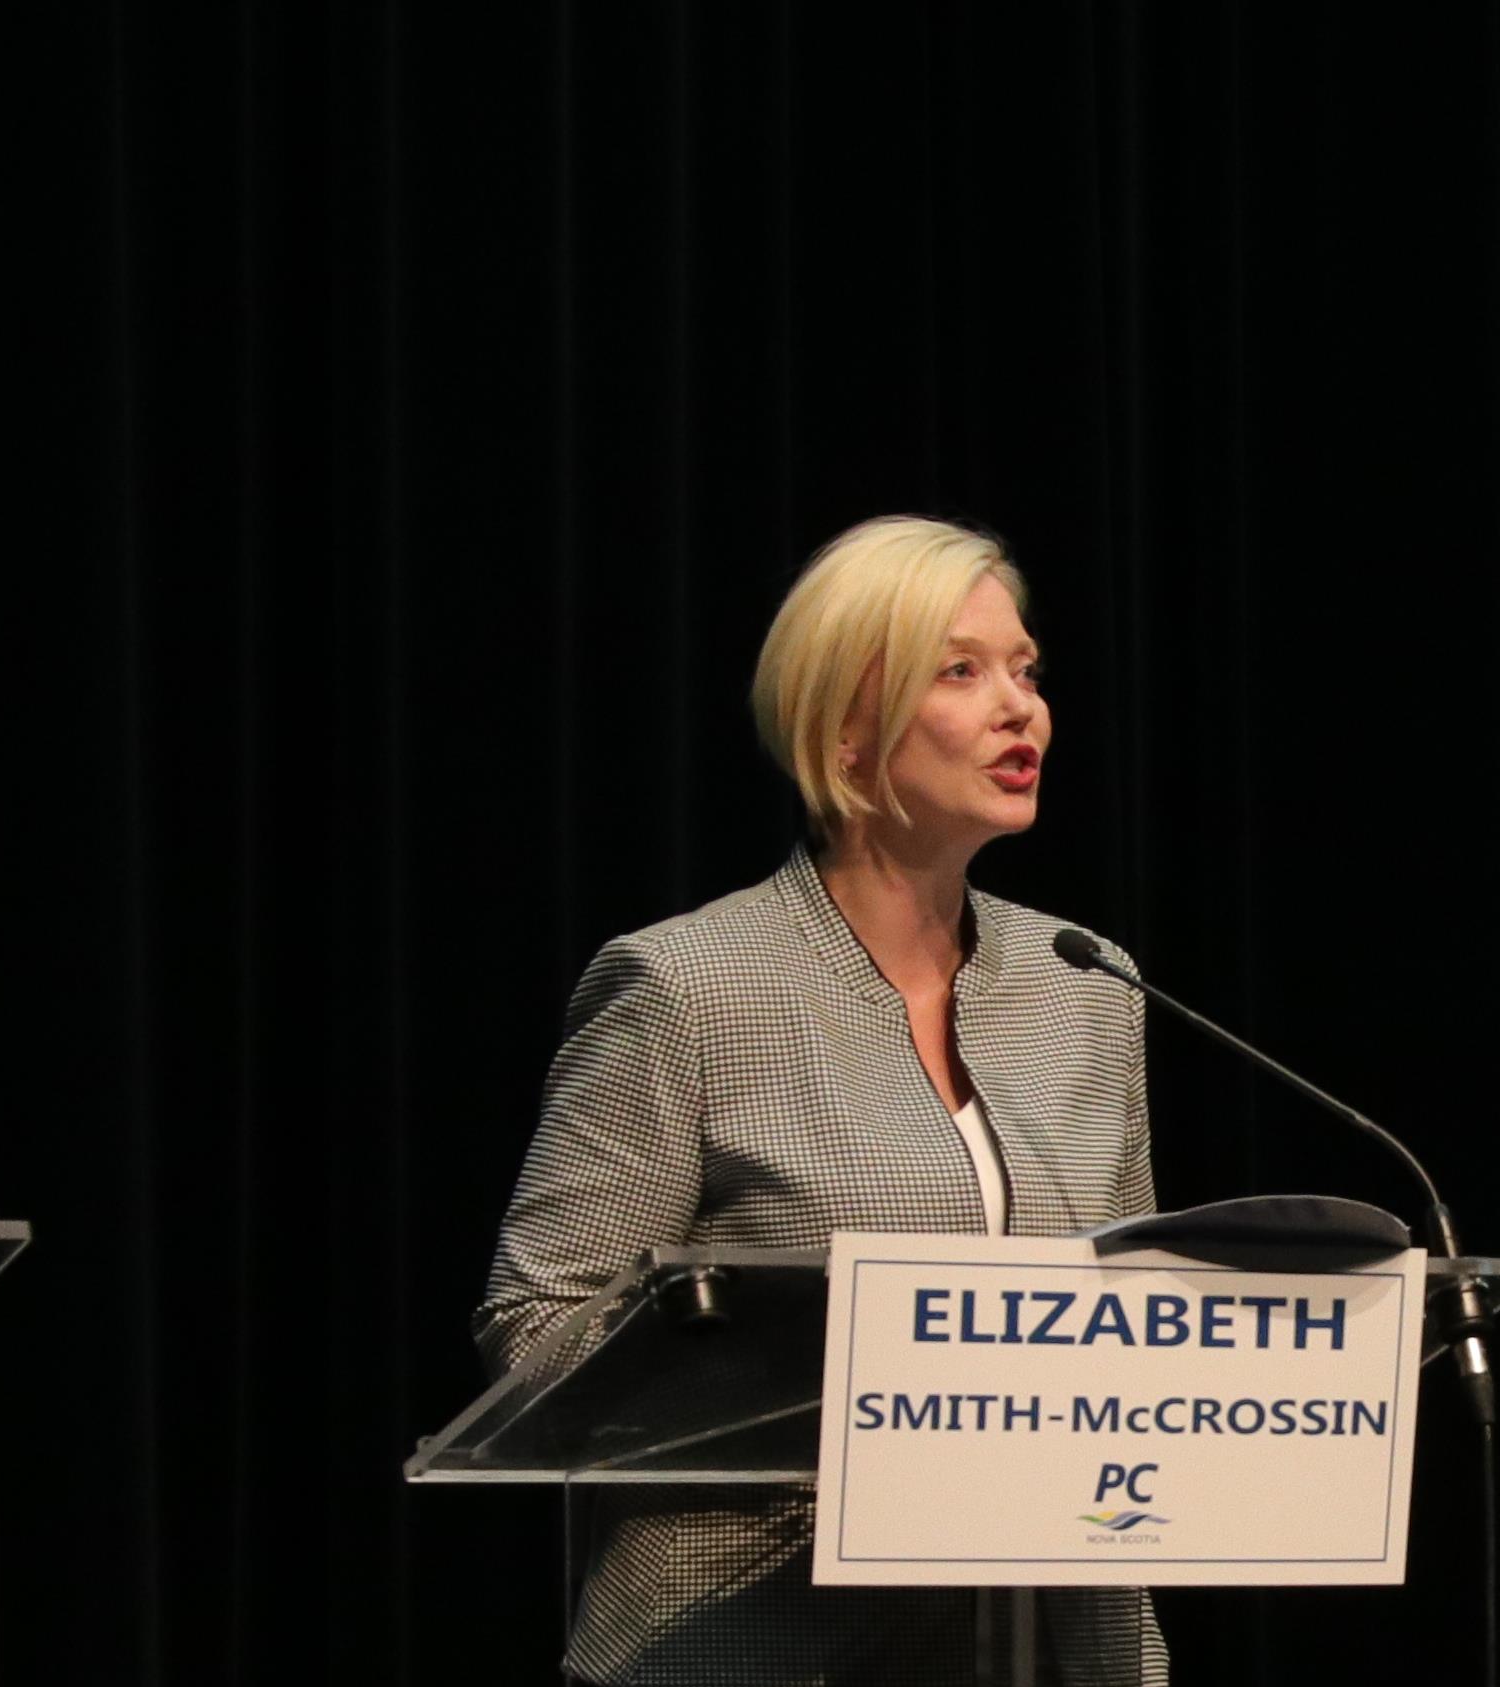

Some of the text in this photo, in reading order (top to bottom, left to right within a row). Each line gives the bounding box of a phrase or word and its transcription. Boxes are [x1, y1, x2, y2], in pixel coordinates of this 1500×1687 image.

[912, 1288, 1348, 1351] ELIZABETH
[854, 1392, 1388, 1437] SMITH-McCROSSIN
[1093, 1462, 1160, 1505] PC
